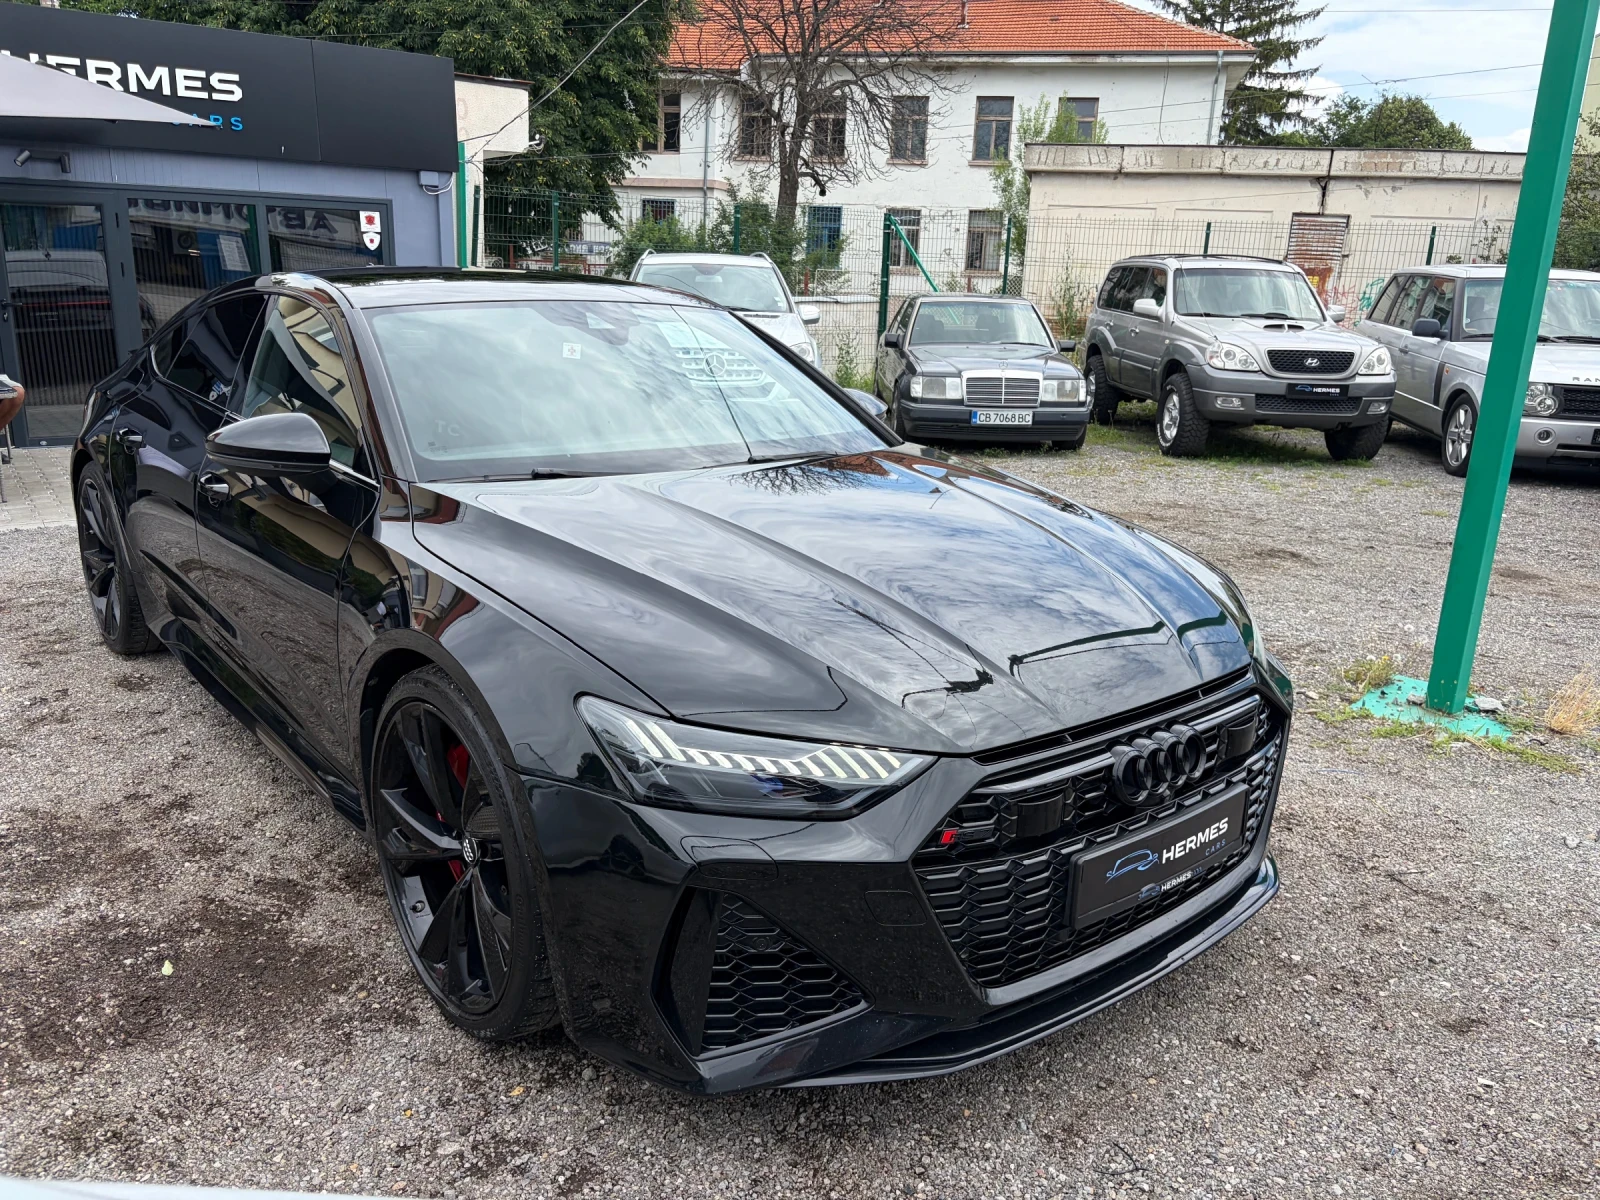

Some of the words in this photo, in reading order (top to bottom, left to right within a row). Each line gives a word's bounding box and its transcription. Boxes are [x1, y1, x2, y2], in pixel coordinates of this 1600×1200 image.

[0, 50, 243, 102] RMES
[171, 113, 244, 131] RS
[993, 413, 1017, 423] 7068
[1162, 817, 1229, 865] HERMES
[1205, 839, 1226, 856] CARS
[1161, 871, 1193, 892] HERMES
